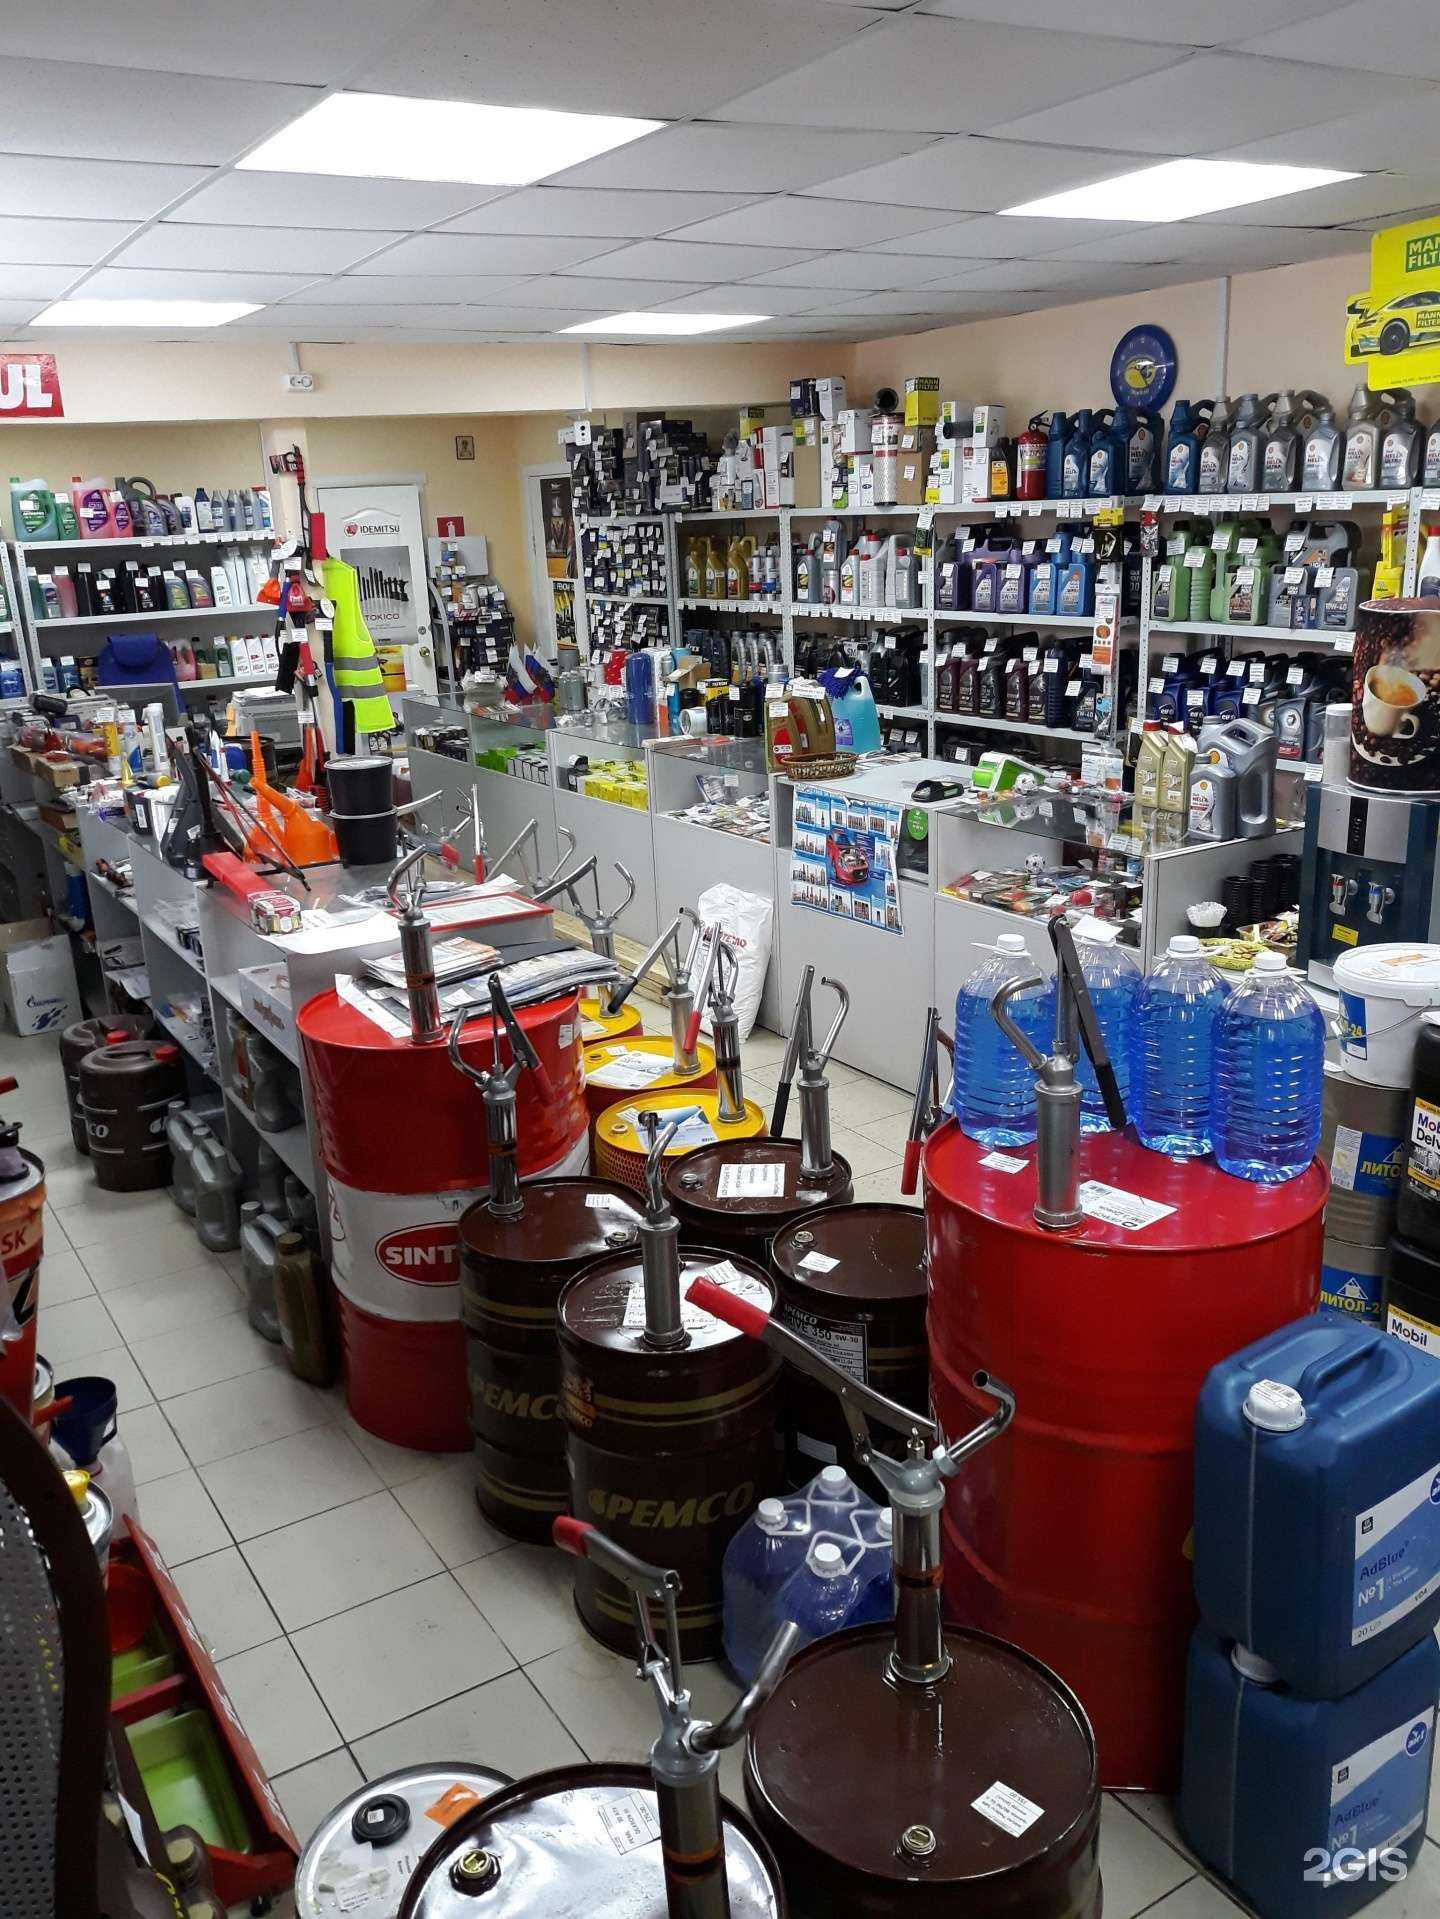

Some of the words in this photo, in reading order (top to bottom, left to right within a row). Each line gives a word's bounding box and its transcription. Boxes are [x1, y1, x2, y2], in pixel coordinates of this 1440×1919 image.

[0, 364, 53, 410] UL
[360, 525, 400, 533] IDEMITSU
[364, 613, 400, 621] TOKICO
[811, 1327, 832, 1341] 350
[1391, 1318, 1428, 1347] Mobil
[603, 1480, 755, 1530] PEMCO
